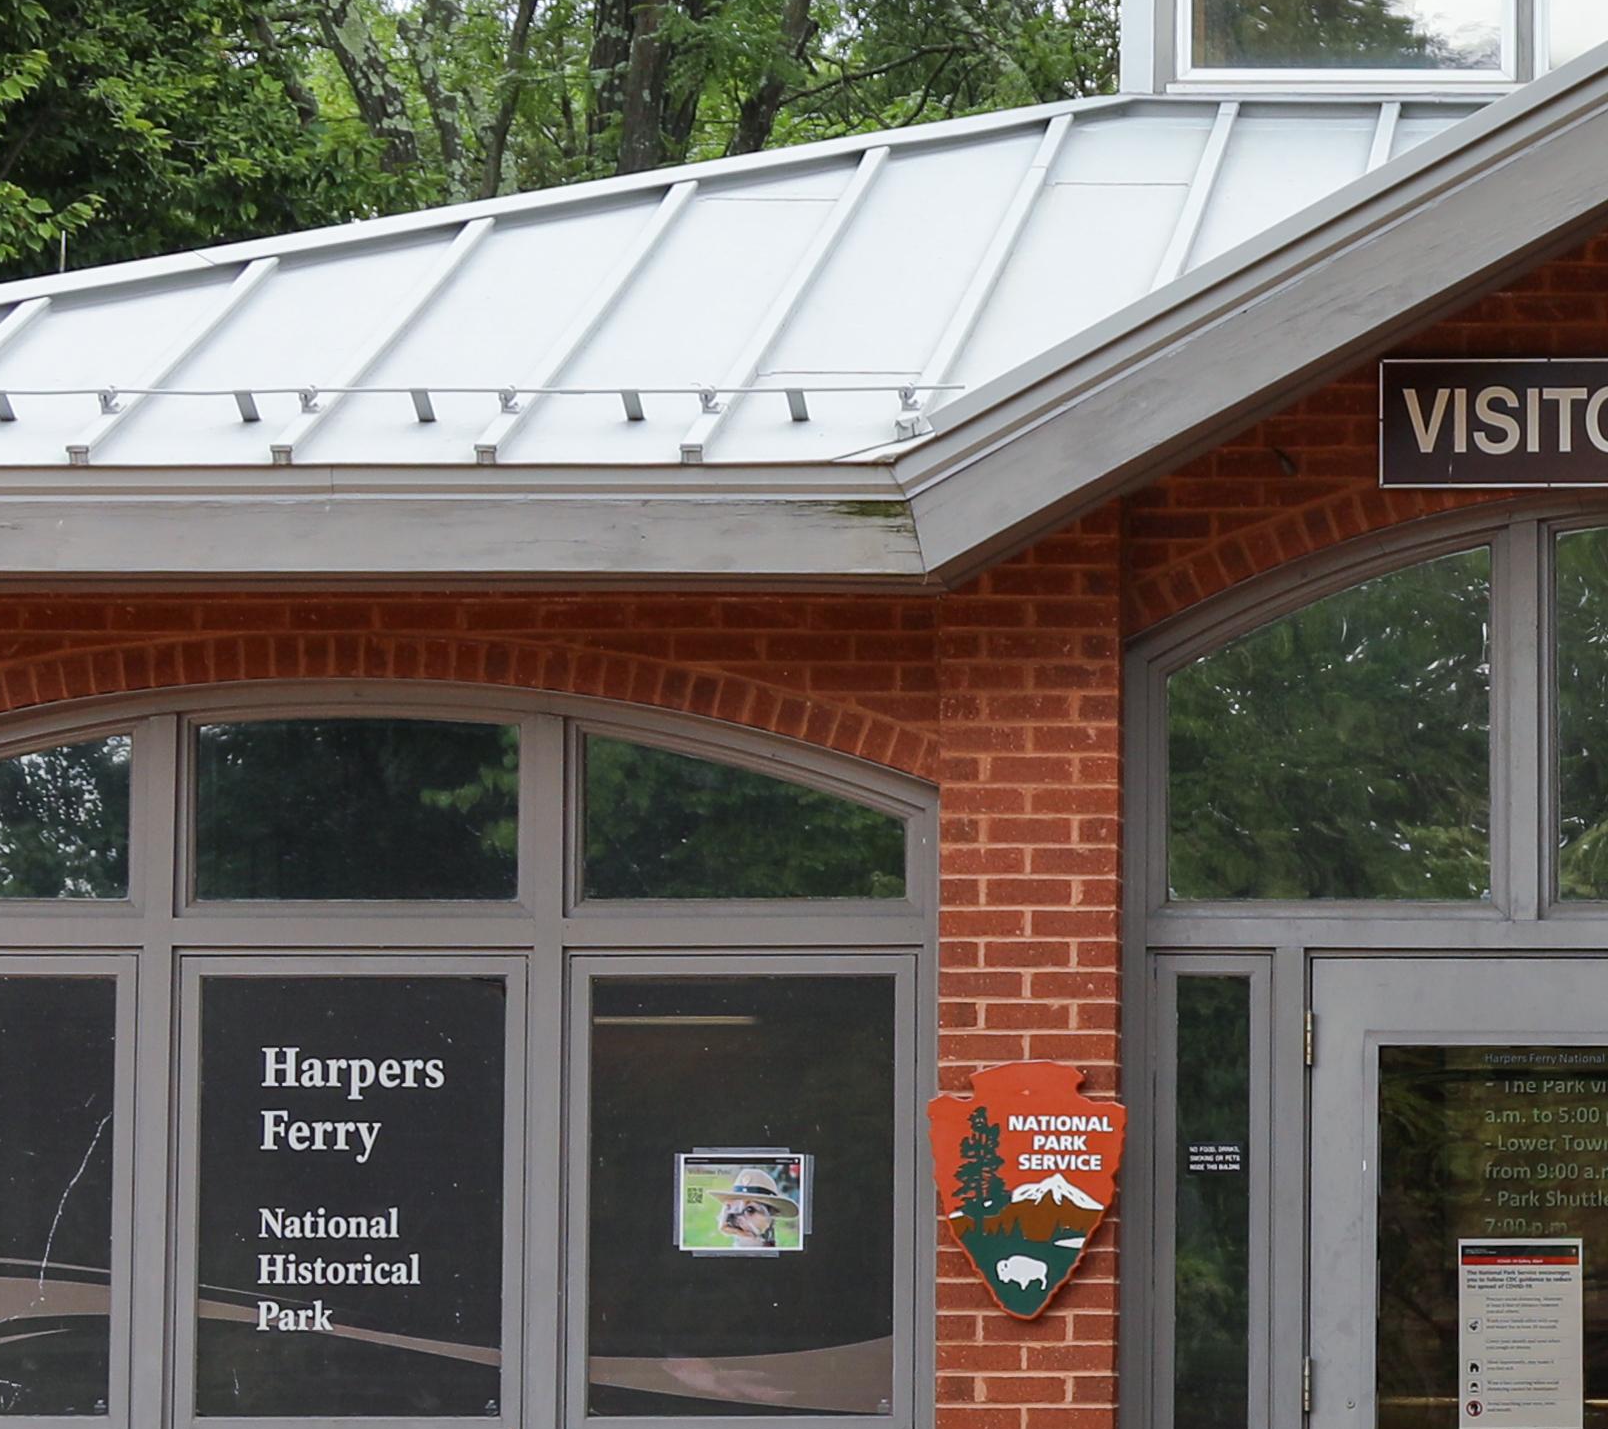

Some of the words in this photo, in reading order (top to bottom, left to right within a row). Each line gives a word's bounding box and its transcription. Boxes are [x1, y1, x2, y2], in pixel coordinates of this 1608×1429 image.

[260, 1046, 445, 1100] Harpers
[1008, 1115, 1113, 1132] NATIONAL
[1485, 1110, 1526, 1123] a.m.
[1533, 1108, 1552, 1122] to
[1559, 1107, 1600, 1122] 5:00
[259, 1110, 381, 1163] Ferry
[1033, 1135, 1087, 1151] PARK
[1498, 1135, 1557, 1151] Lower
[1018, 1154, 1102, 1171] SERVICE
[1485, 1162, 1530, 1179] from
[1537, 1163, 1578, 1179] 9:00
[1497, 1190, 1540, 1207] Park
[258, 1207, 400, 1238] National
[257, 1253, 421, 1284] Historical
[256, 1300, 334, 1331] Park
